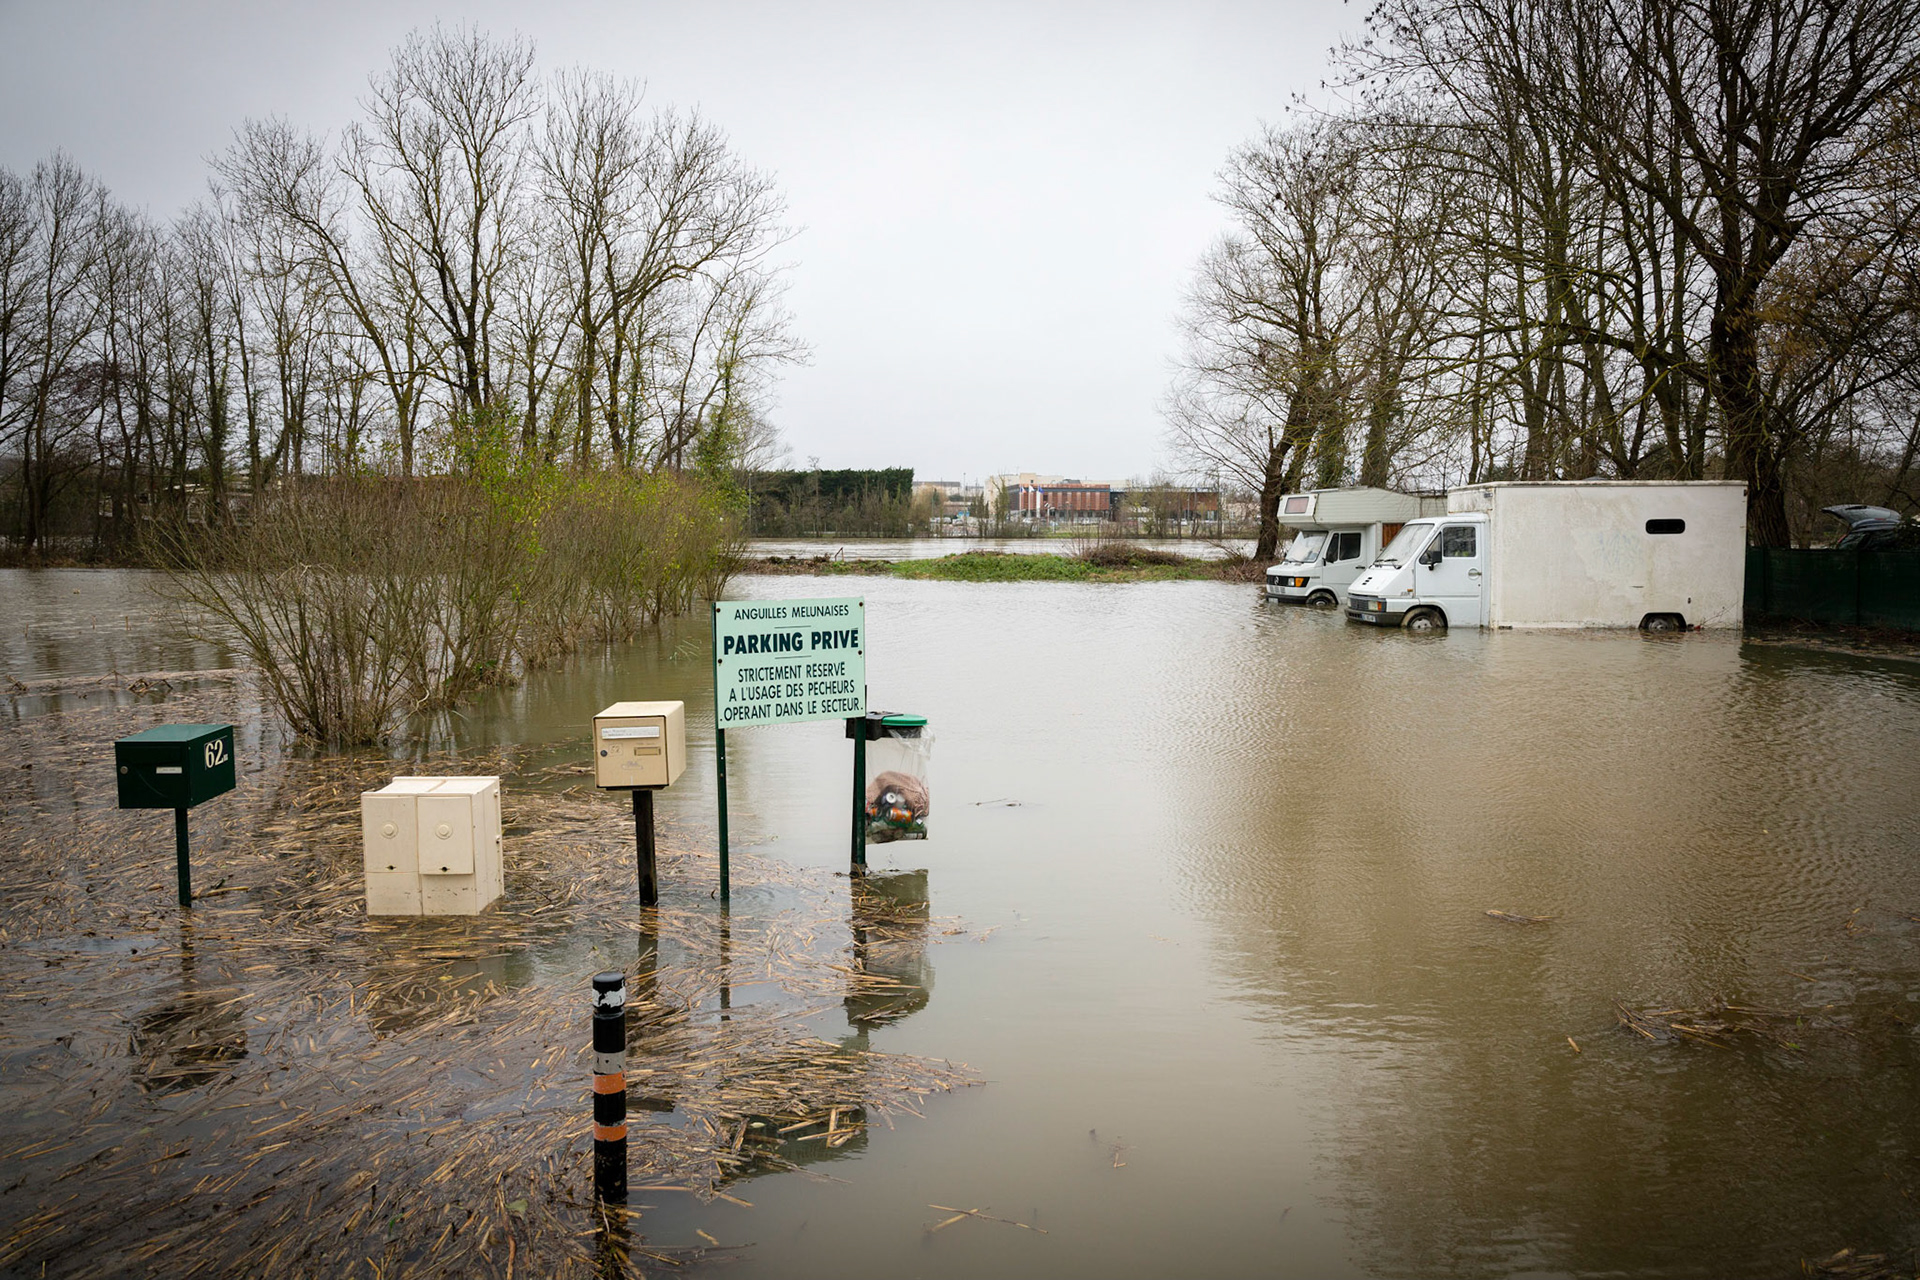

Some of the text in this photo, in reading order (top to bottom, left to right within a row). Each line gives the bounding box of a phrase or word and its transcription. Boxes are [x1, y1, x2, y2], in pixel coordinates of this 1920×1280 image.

[734, 604, 849, 621] ANGUILLES MELUNAISES
[723, 632, 803, 655] PARKING
[738, 661, 845, 683] STRICTEMENT RESERVE
[728, 679, 855, 702] A L'USAGE DES PECHEURS
[775, 701, 803, 717] DANS
[808, 700, 817, 714] LE
[205, 739, 223, 768] 62
